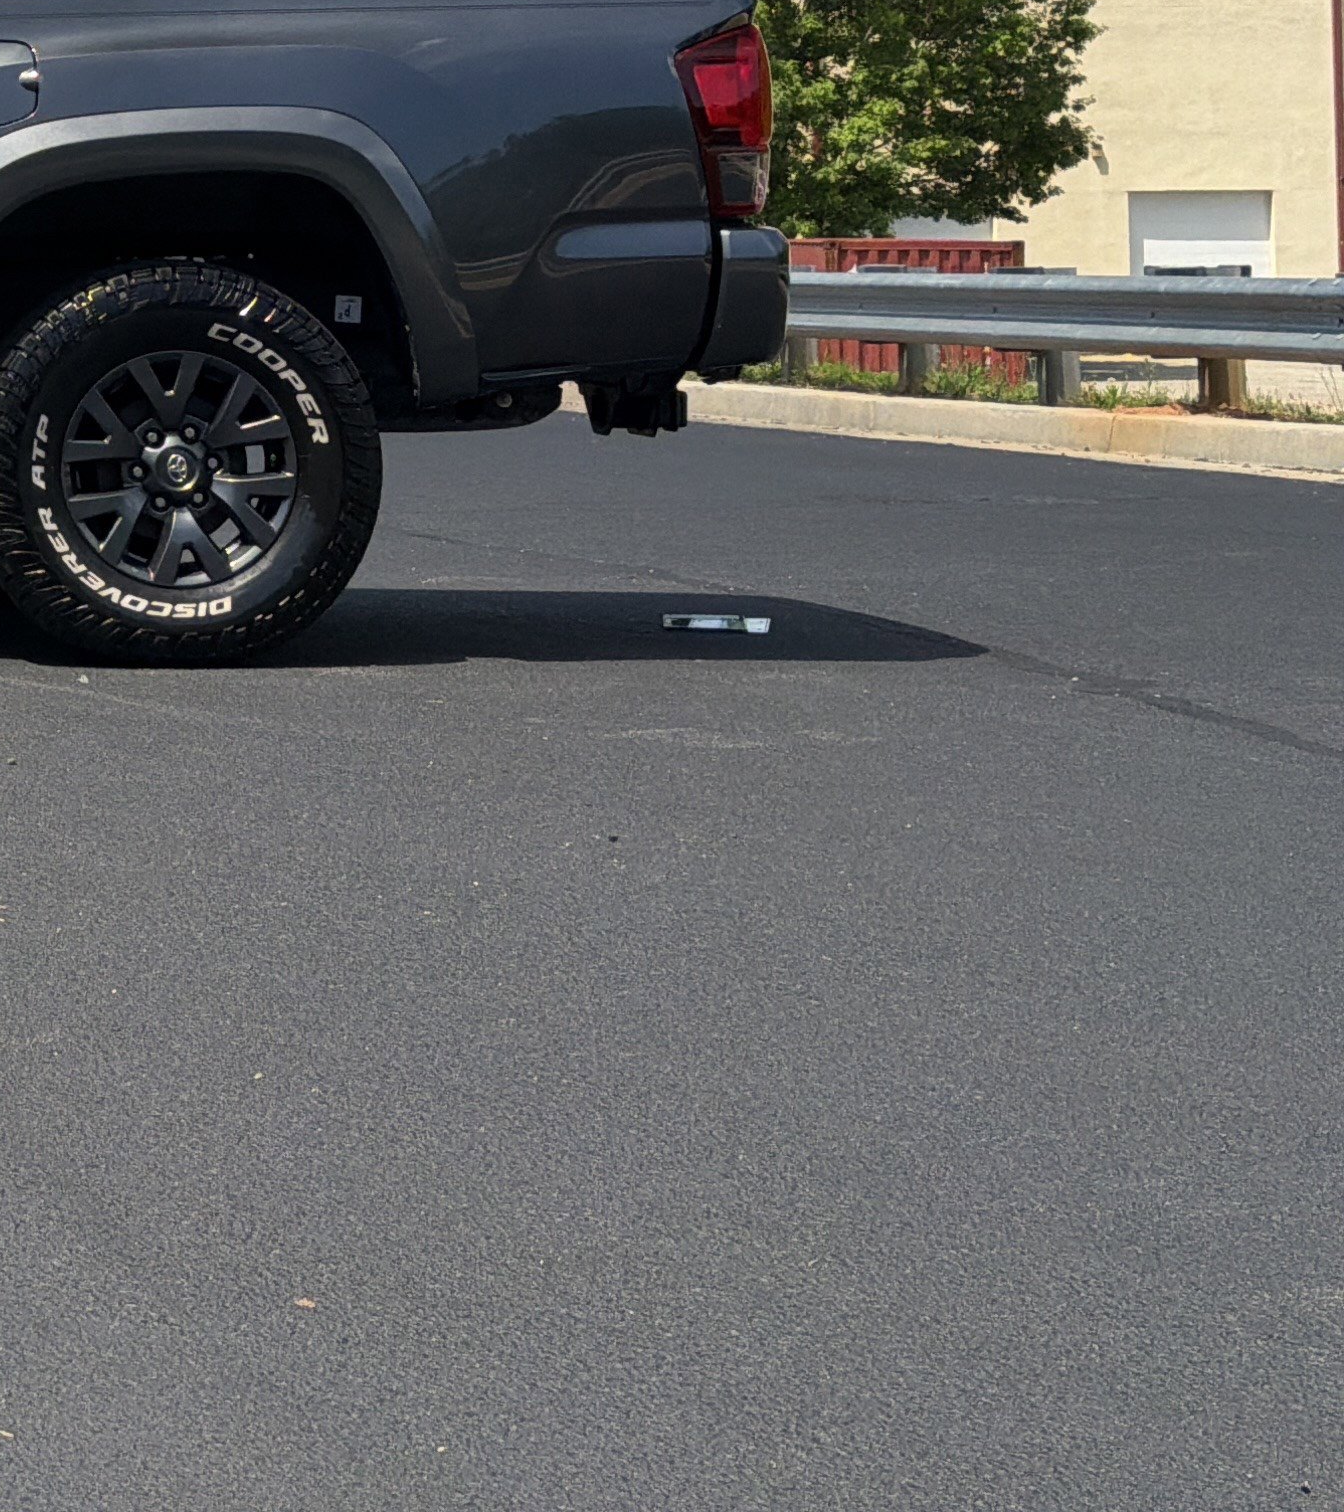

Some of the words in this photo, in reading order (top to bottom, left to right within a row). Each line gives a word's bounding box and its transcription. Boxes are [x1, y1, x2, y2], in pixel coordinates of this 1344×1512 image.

[207, 322, 330, 445] COOPER
[30, 413, 50, 489] ATP
[36, 506, 233, 618] DISCOVERER
